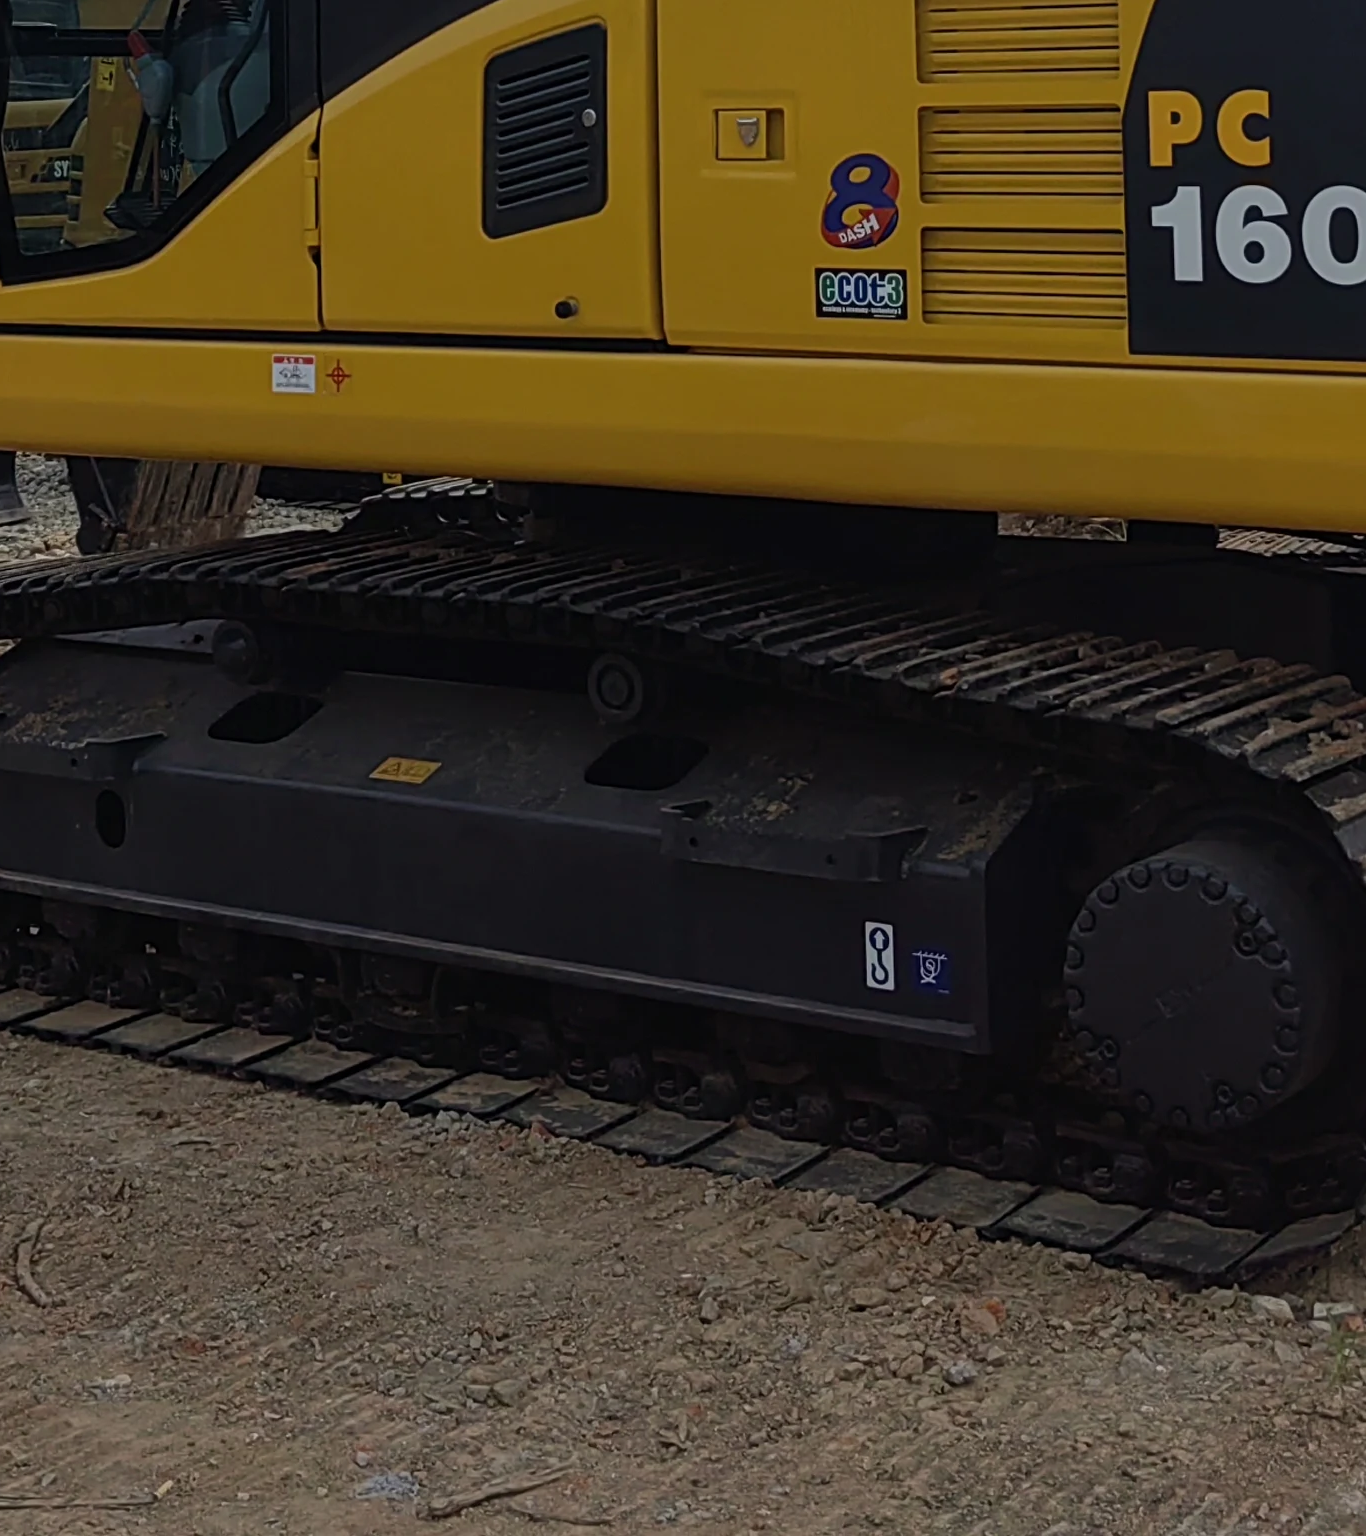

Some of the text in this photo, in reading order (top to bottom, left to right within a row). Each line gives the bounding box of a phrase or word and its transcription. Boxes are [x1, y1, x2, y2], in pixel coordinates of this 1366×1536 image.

[1148, 90, 1270, 167] PC
[821, 153, 899, 249] 8
[838, 212, 881, 245] DASH
[820, 272, 904, 306] ecot3
